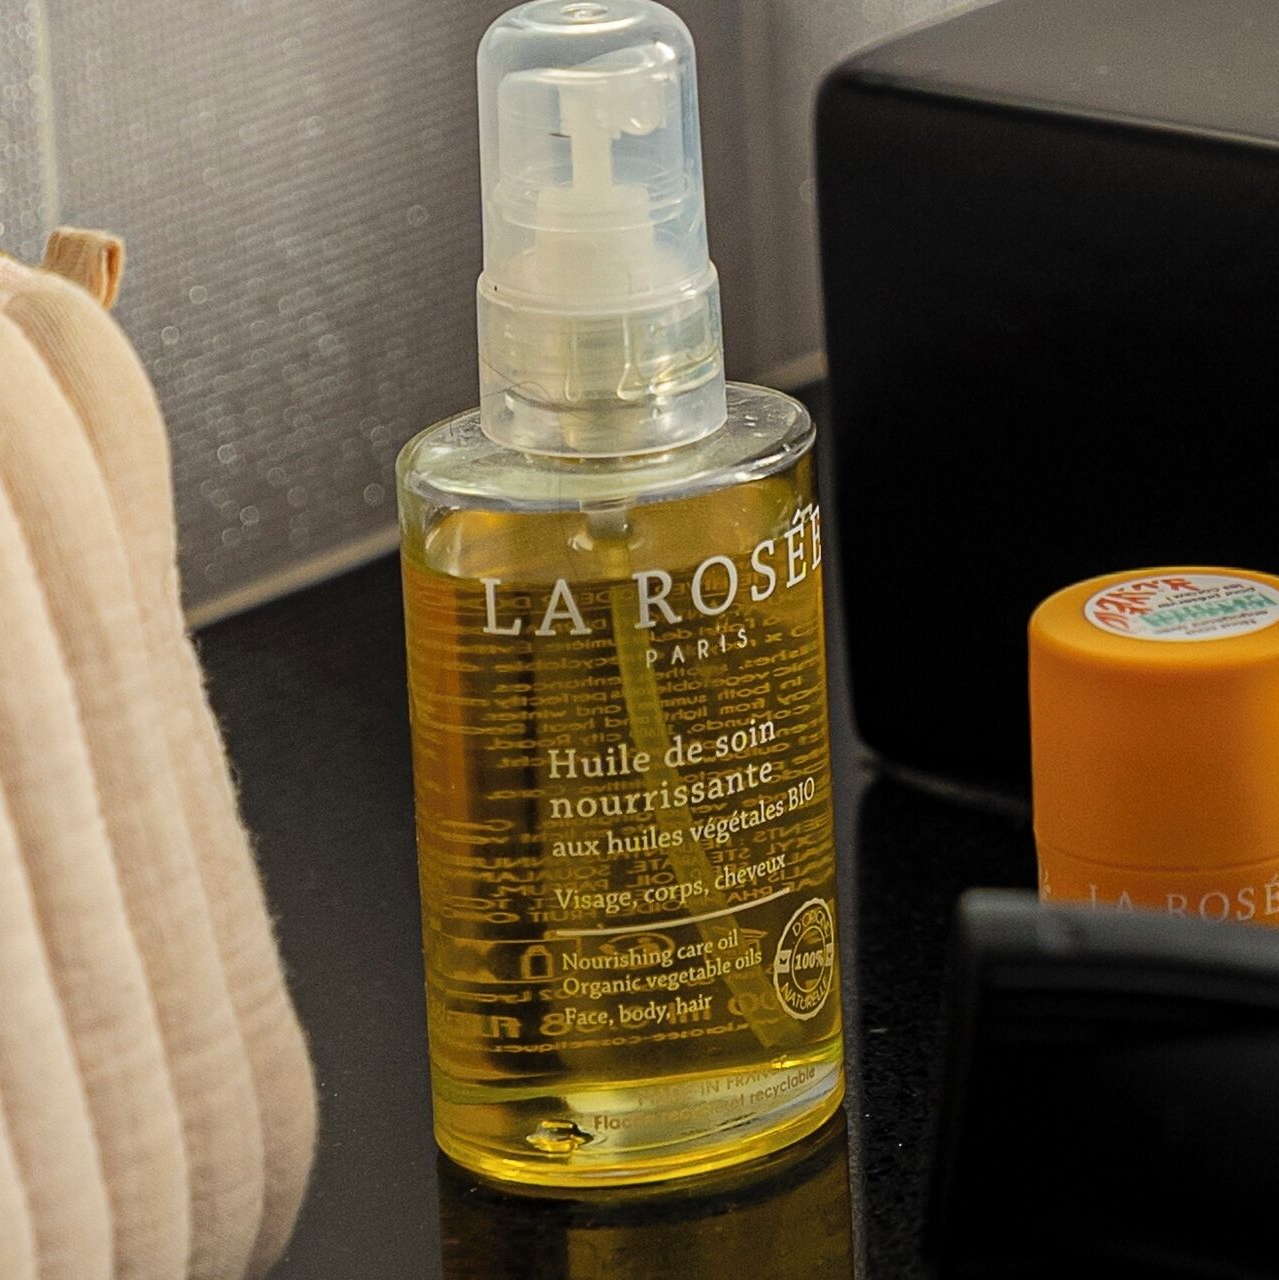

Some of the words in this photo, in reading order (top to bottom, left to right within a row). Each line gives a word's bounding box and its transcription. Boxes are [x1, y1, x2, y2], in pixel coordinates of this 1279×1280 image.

[479, 577, 592, 636] LA
[633, 502, 822, 630] ROSÉE
[647, 628, 748, 668] PARIS
[548, 744, 650, 779] Huile
[664, 735, 703, 768] de
[716, 718, 776, 757] soin
[549, 761, 773, 819] nourrissante
[552, 840, 600, 857] aux
[607, 826, 683, 855] huiles
[690, 799, 785, 845] végétales
[788, 777, 816, 812] BIO
[554, 888, 638, 913] Visage,
[644, 877, 710, 907] corps,
[715, 854, 787, 890] cheveux
[562, 948, 673, 971] Nourishing
[677, 939, 713, 960] care
[718, 929, 739, 950] oil
[563, 975, 641, 999] Organic
[646, 959, 730, 991] vegetable
[734, 949, 762, 969] oils
[794, 950, 824, 971] 100%
[565, 1007, 614, 1027] Face,
[619, 1001, 671, 1024] body,
[676, 994, 713, 1015] hair
